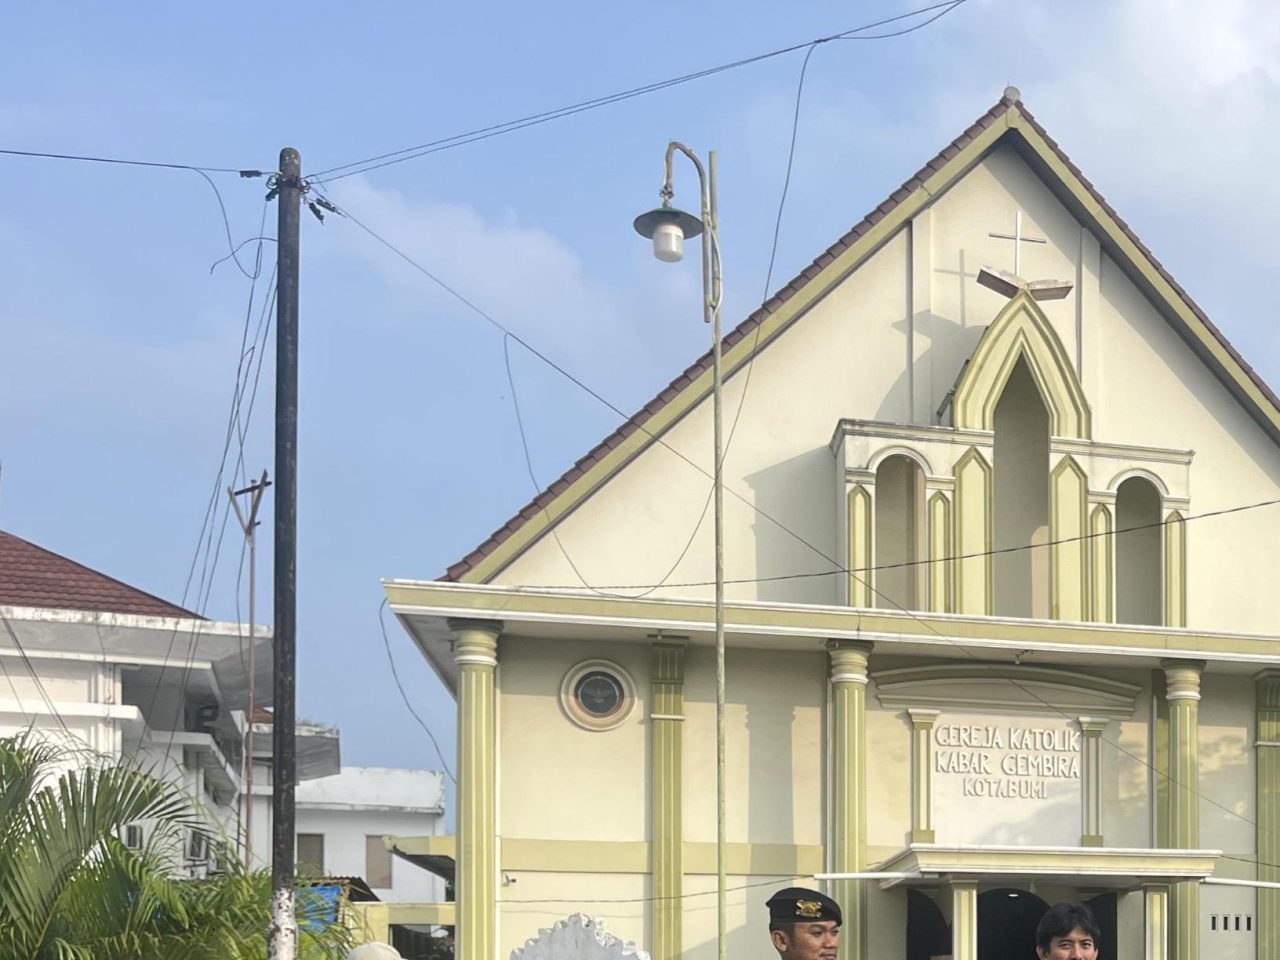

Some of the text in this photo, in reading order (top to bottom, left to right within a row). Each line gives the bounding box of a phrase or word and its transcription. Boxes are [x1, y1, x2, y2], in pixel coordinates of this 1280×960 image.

[935, 724, 1081, 752] GEREJA KATOLIK
[935, 751, 1080, 779] KABAR GEMBIRA
[963, 778, 1047, 800] KOTABUMI
